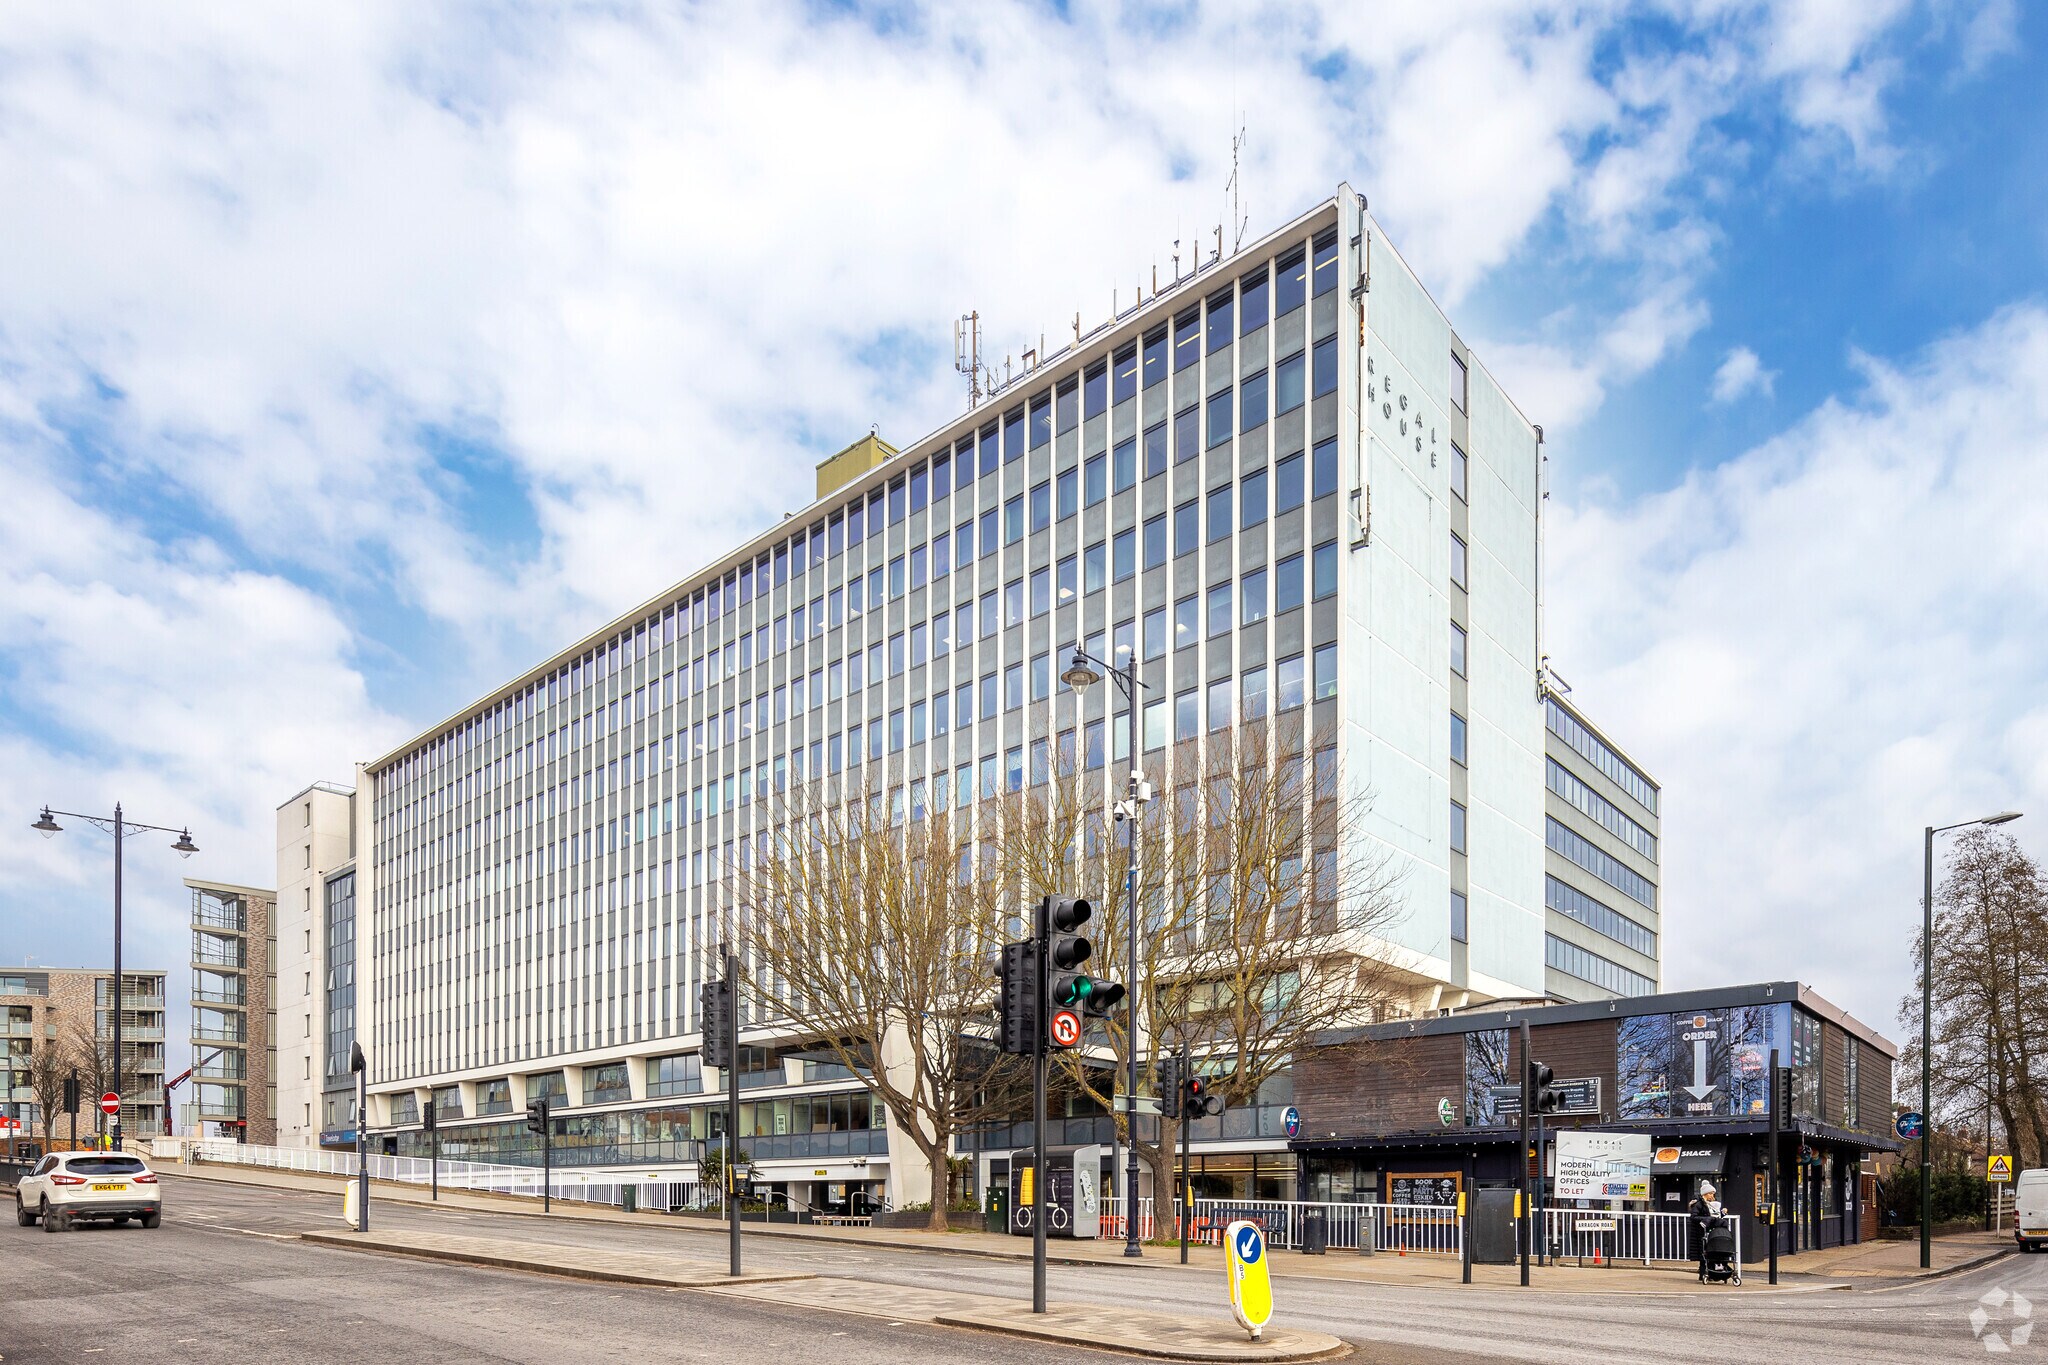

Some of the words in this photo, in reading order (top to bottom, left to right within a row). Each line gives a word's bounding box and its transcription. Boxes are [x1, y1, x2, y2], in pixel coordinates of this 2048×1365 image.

[1367, 356, 1437, 444] REGAL
[1367, 383, 1437, 468] HOUSE
[1682, 1031, 1717, 1041] ORDER
[1687, 1102, 1713, 1111] HERE
[1560, 1161, 1592, 1169] MODERN
[1581, 1170, 1611, 1178] QUALITY
[1413, 1187, 1435, 1195] PARTY
